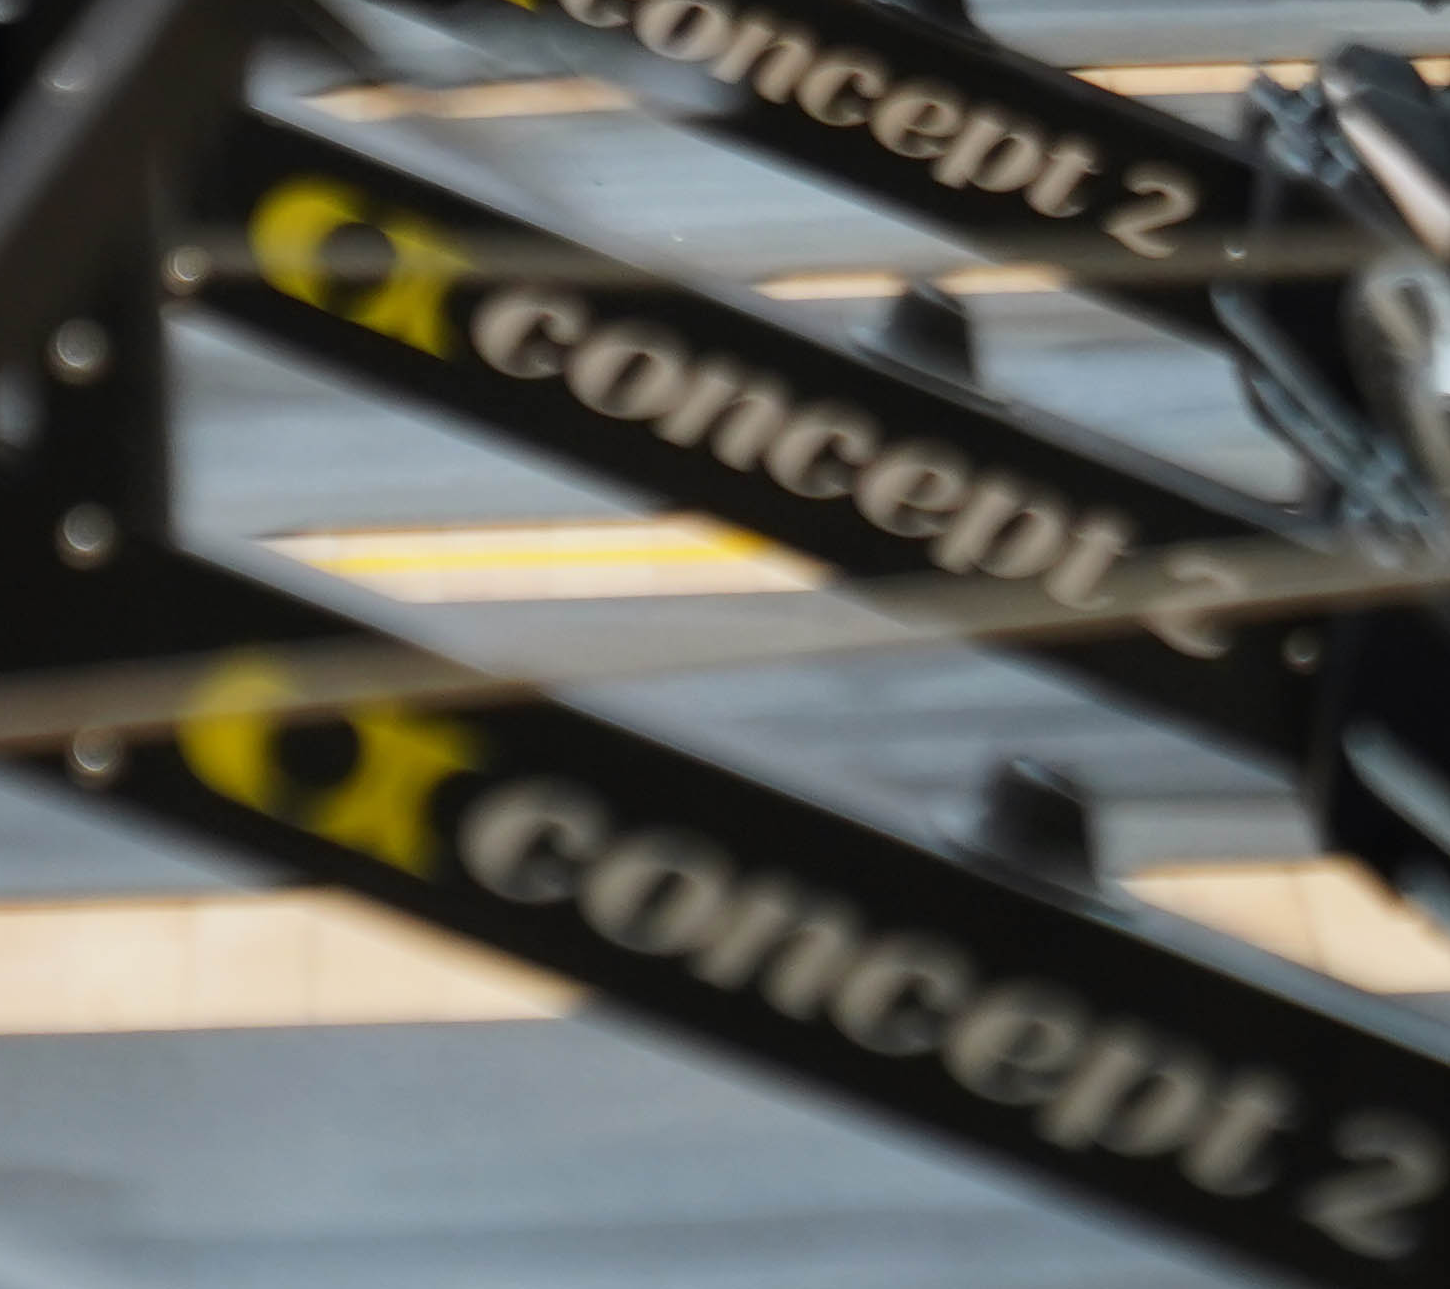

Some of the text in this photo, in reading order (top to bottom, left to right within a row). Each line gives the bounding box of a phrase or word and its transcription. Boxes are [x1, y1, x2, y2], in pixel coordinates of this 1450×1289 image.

[1103, 159, 1200, 263] 2
[470, 283, 1248, 661] concept 2
[455, 773, 1301, 1199] concept
